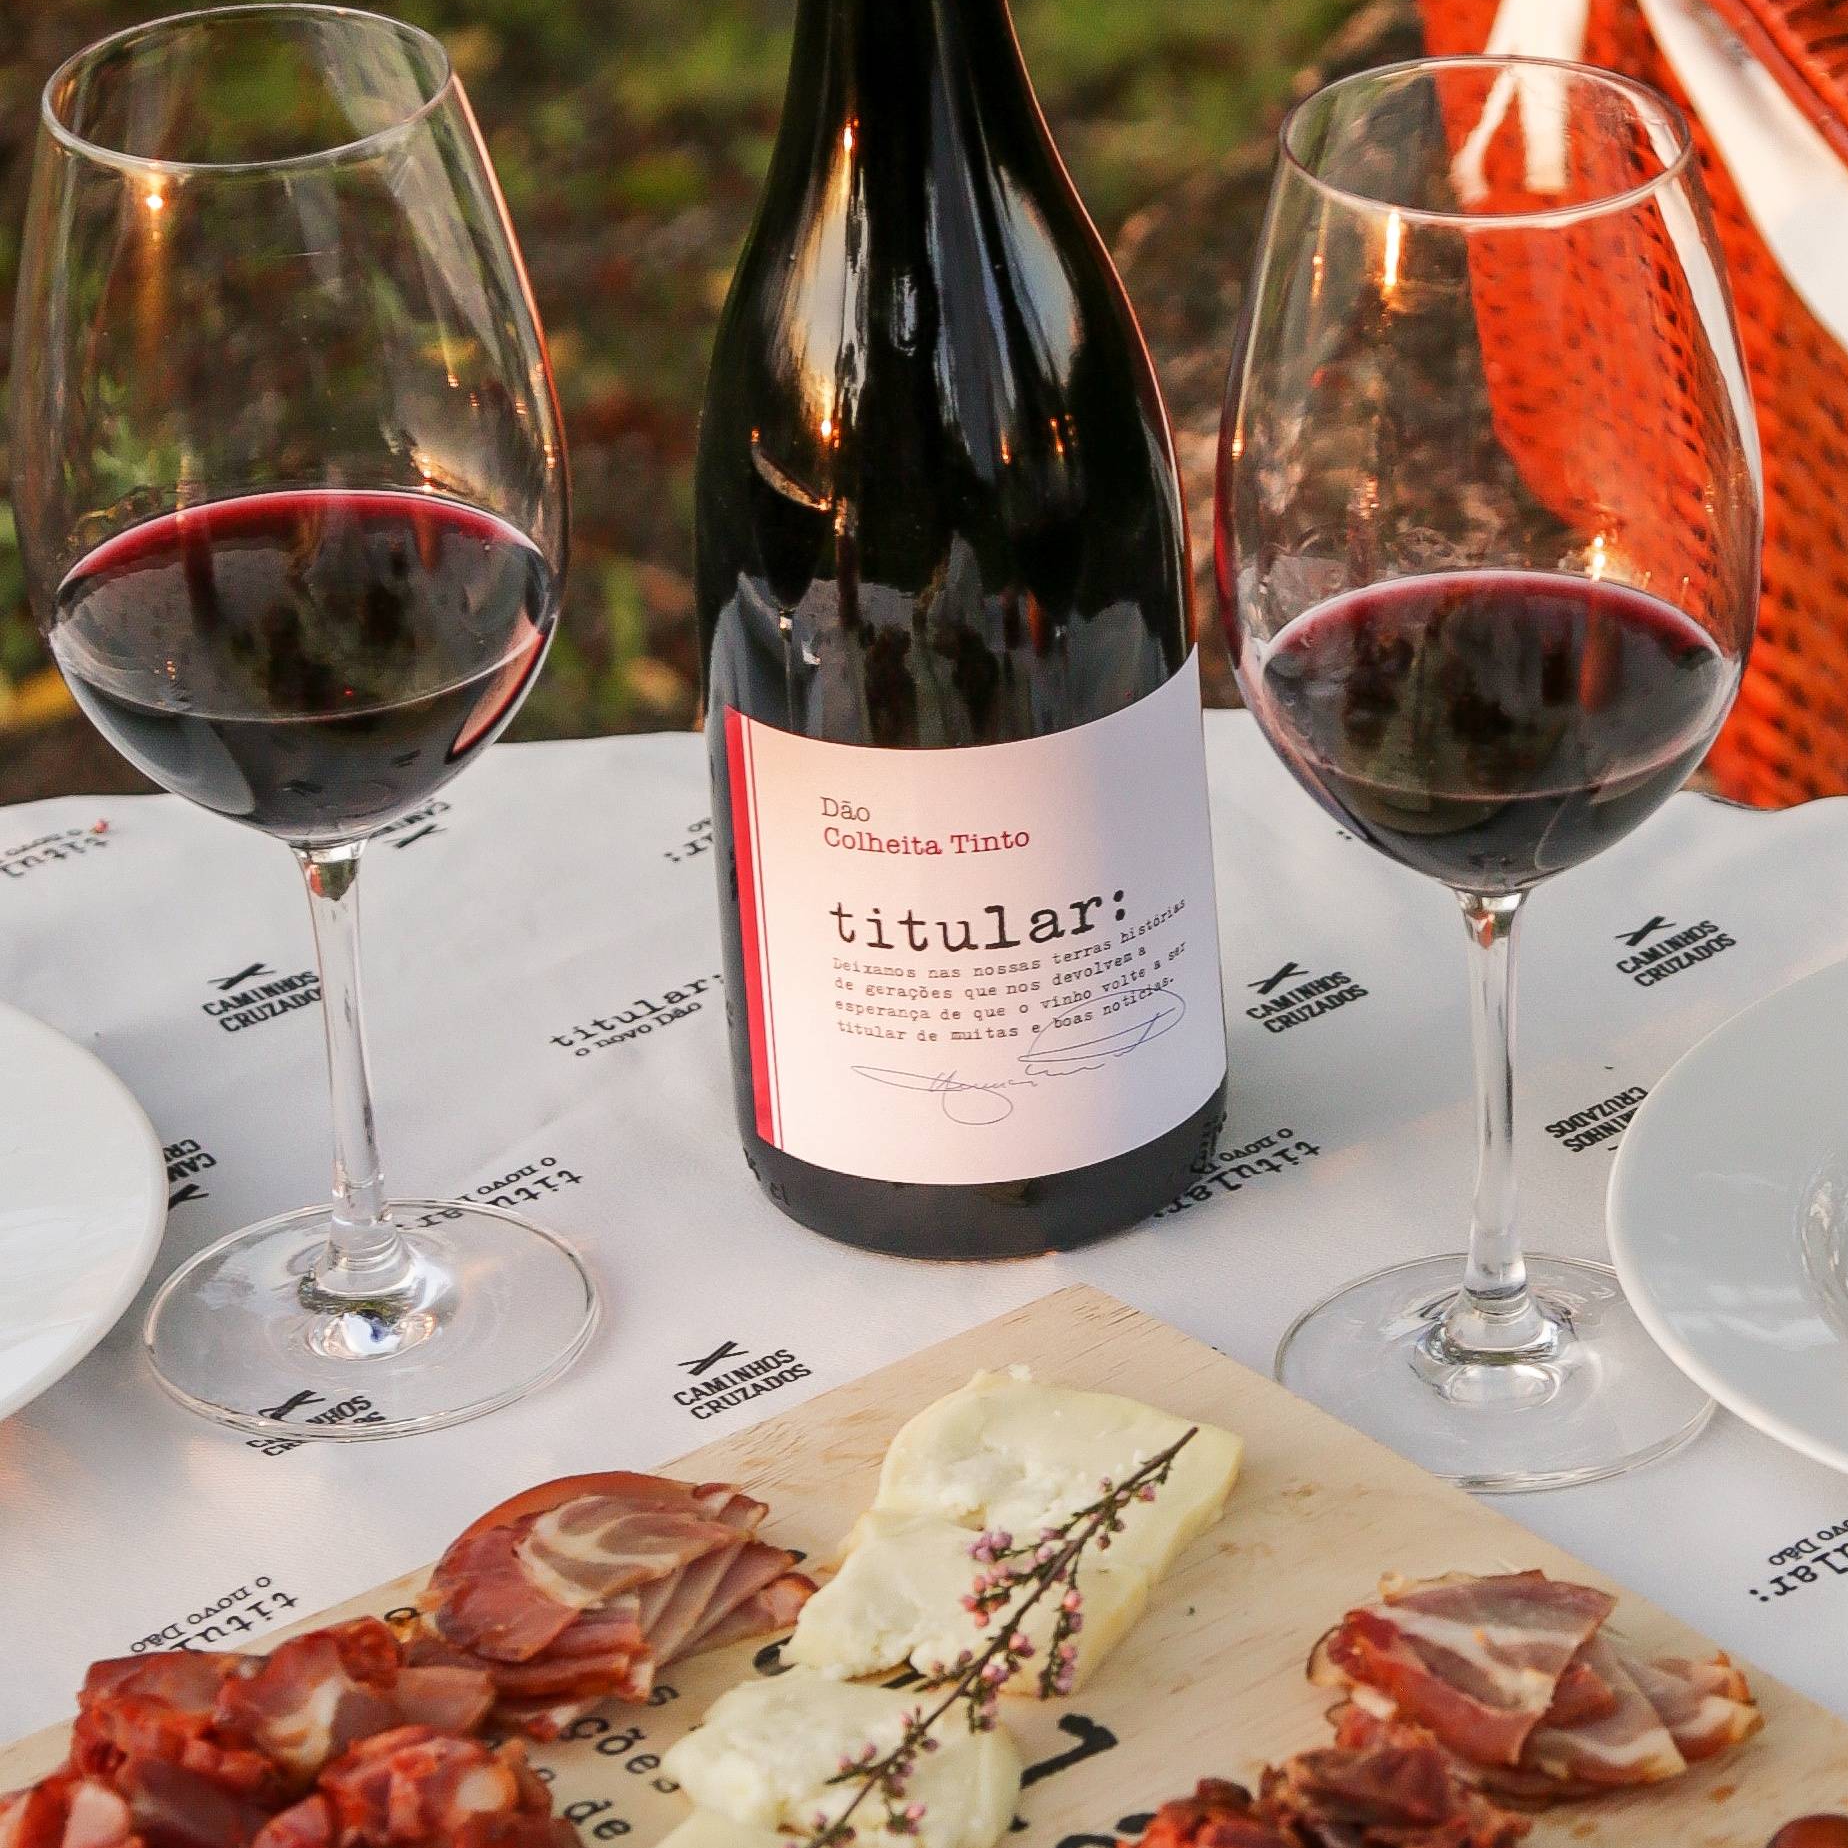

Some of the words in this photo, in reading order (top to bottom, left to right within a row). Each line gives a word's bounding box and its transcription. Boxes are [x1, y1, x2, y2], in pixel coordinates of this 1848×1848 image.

[821, 797, 870, 822] Dão
[824, 827, 942, 855] Colheita
[951, 831, 1030, 854] Tinto
[829, 889, 1126, 952] titular:
[833, 957, 916, 978] Deixamos
[928, 968, 961, 978] nas
[973, 958, 1041, 977] nossas
[1052, 940, 1111, 965] terras
[1616, 920, 1719, 973] CAMINHOS
[1634, 933, 1737, 986] CRUZADOS
[203, 971, 319, 1016] CAMINHOS
[834, 977, 853, 990] de
[866, 984, 953, 1001] gerações
[964, 985, 998, 1000] que
[1006, 981, 1041, 995] nos
[1052, 954, 1133, 987] devolvem
[1139, 947, 1146, 956] a
[835, 1000, 931, 1021] esperança
[940, 1009, 961, 1020] de
[973, 1007, 1006, 1021] que
[1019, 1004, 1028, 1013] o
[1040, 989, 1091, 1009] vinho
[1102, 969, 1146, 992] volte
[1154, 960, 1161, 970] a
[1168, 942, 1186, 962] ser
[1246, 971, 1352, 1019] CAMINHOS
[219, 987, 323, 1032] CRUZADO
[575, 1047, 590, 1056] o
[595, 1023, 652, 1048] novo
[652, 1002, 703, 1027] Dão
[837, 1021, 907, 1040] titular
[916, 1030, 937, 1042] de
[950, 1026, 1018, 1041] muitas
[1032, 1024, 1041, 1033] e
[1053, 1011, 1094, 1029] boas
[1263, 984, 1369, 1033] CRUZADOS
[1276, 1127, 1293, 1138] o
[1545, 1086, 1648, 1138] CRUZADOS
[540, 1157, 556, 1167] o
[1219, 1136, 1277, 1161] novo
[477, 1165, 539, 1195] novo
[674, 1349, 796, 1406] CAMINHOS
[690, 1364, 812, 1420] CRUZADOS
[1769, 1538, 1821, 1566] Dão
[256, 1576, 271, 1588] o
[187, 1586, 252, 1625] novo
[131, 1623, 186, 1653] Dão
[563, 1799, 631, 1841] de
